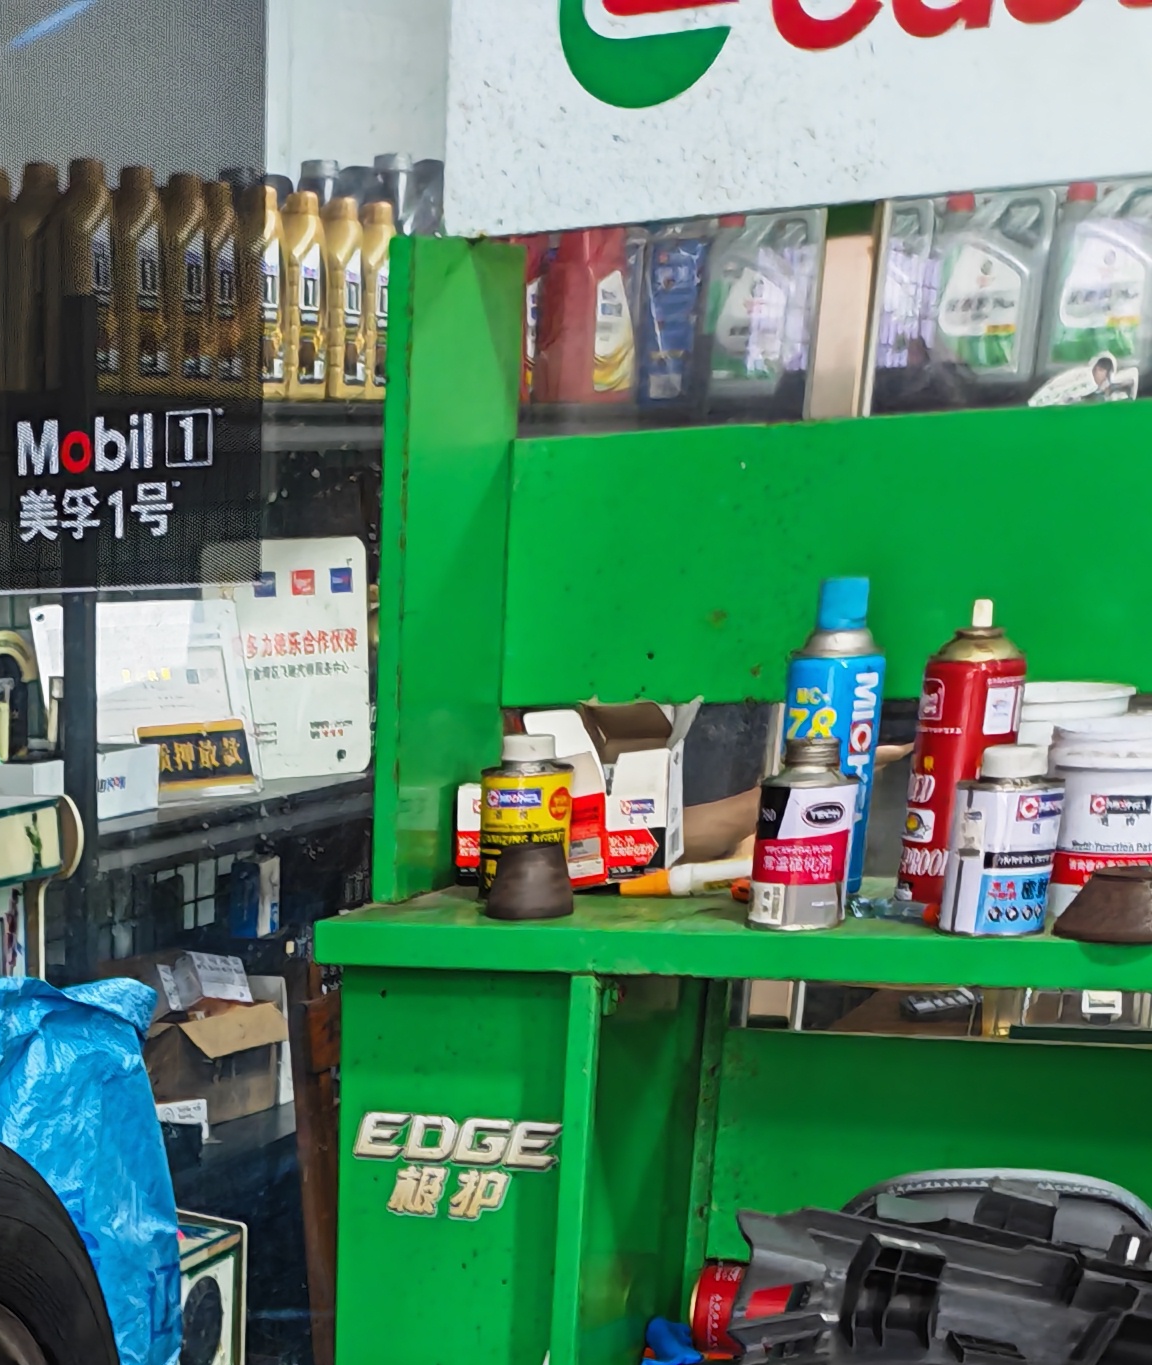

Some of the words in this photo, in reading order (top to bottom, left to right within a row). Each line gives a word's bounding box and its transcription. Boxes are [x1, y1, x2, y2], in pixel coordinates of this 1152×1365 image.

[17, 412, 153, 476] Mobil
[19, 481, 174, 543] 美孚1号
[352, 1111, 563, 1172] EDGE
